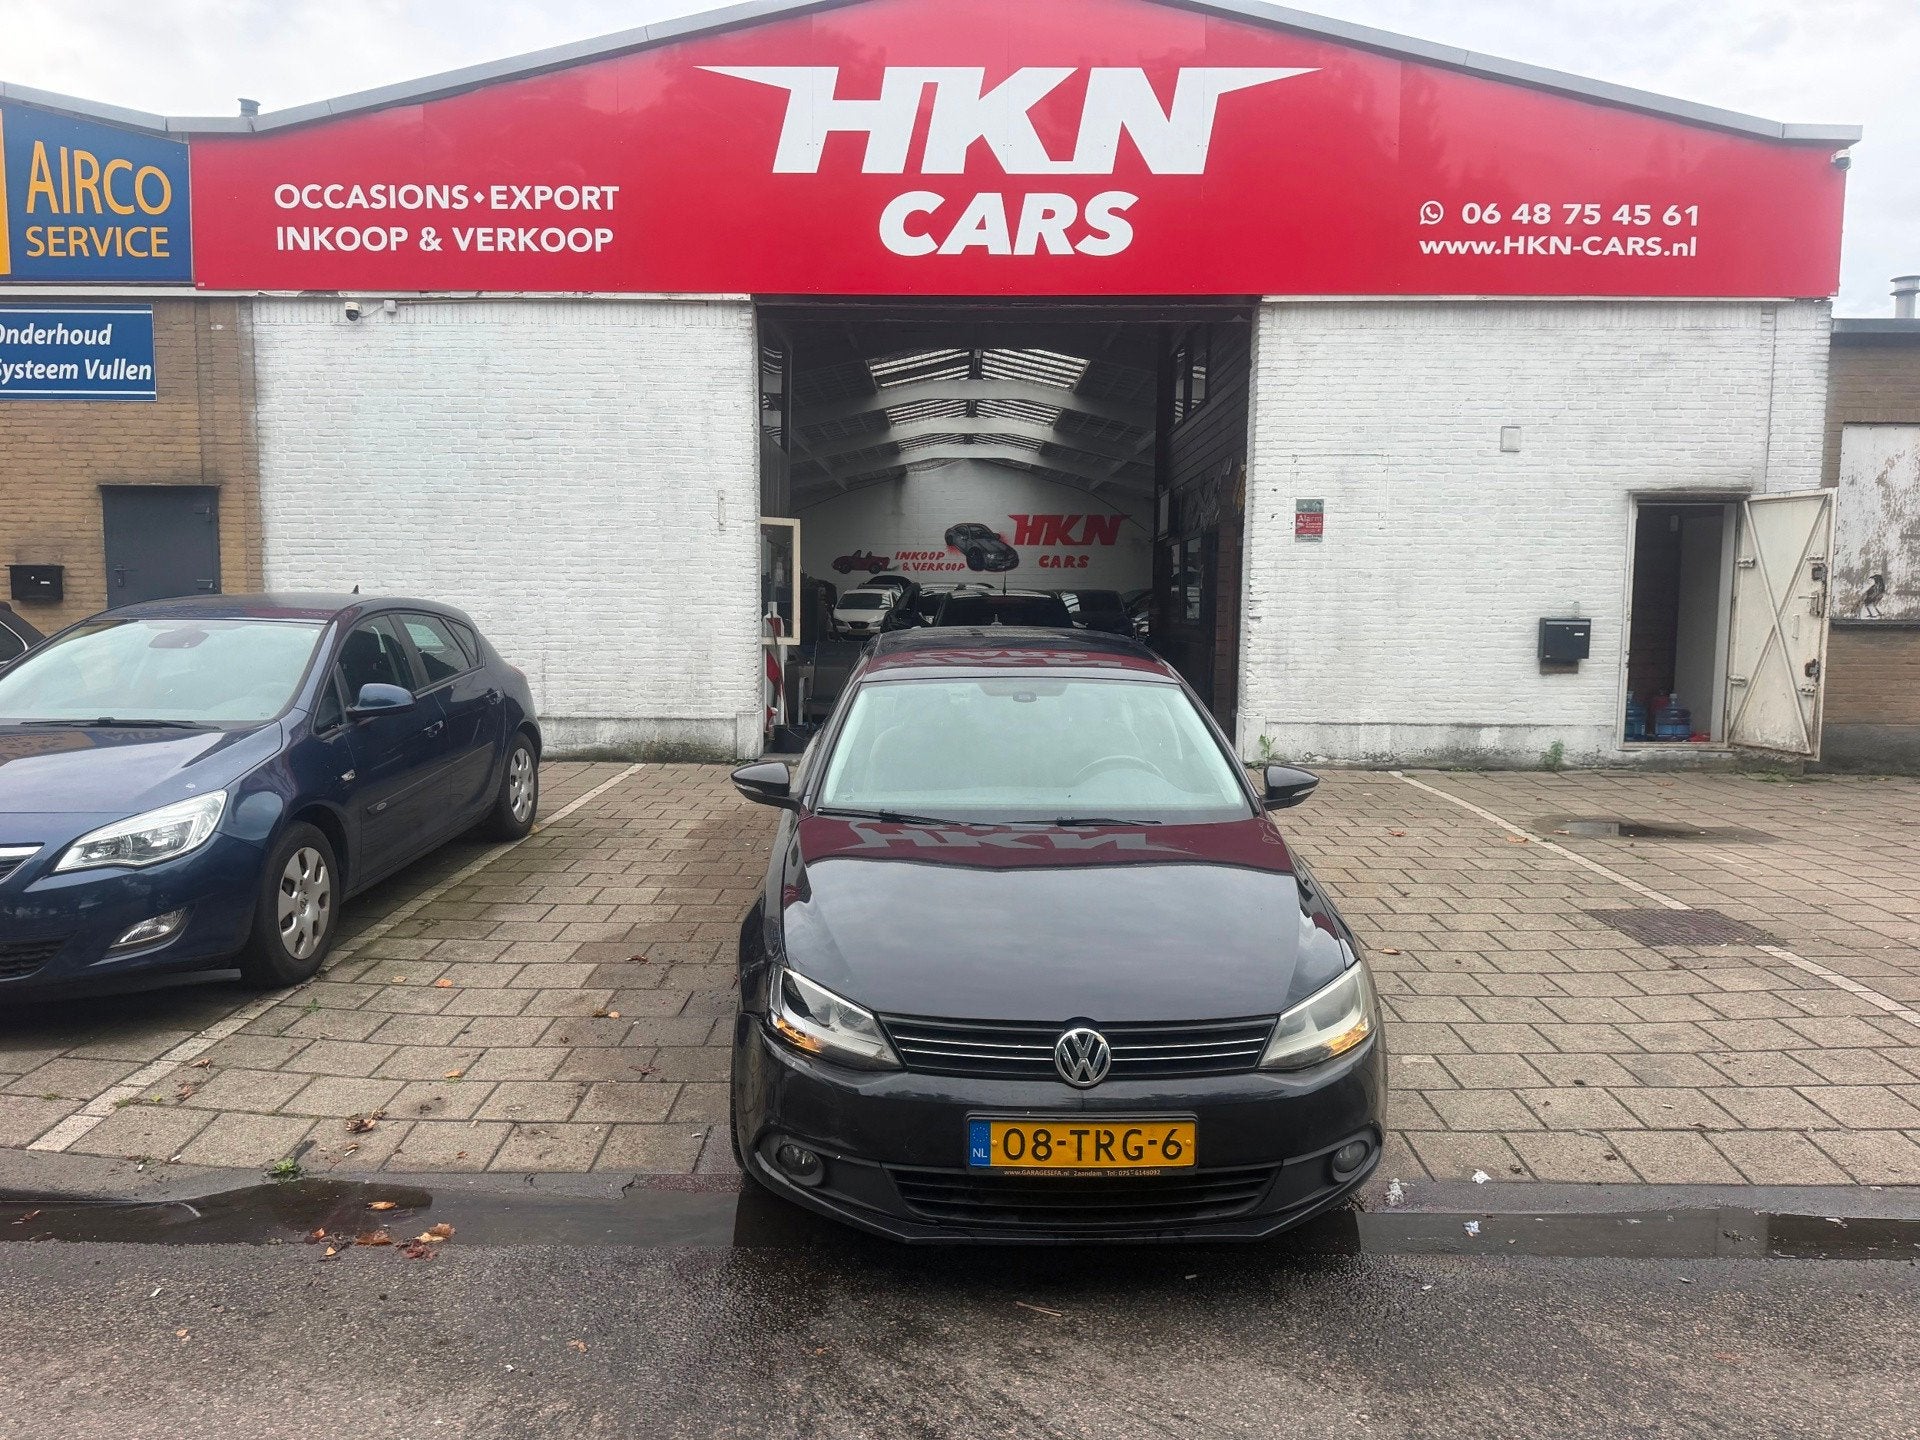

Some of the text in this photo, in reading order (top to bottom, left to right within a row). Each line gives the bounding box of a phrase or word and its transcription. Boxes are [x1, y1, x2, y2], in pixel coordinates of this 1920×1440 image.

[692, 65, 1324, 175] HKN
[26, 140, 172, 216] AIRCO
[274, 183, 620, 211] OCCASIONS EXPORT
[878, 190, 1140, 257] CARS
[1461, 202, 1699, 227] 06 48 75 45 61
[25, 225, 170, 259] SERVICE
[276, 226, 614, 253] INKOOP & VERKOOP
[1419, 235, 1697, 257] www.HKN-CARS.nl
[0, 358, 152, 386] ysteem Vullen
[1008, 514, 1133, 546] HKN
[895, 551, 946, 561] INKOOP
[902, 562, 966, 572] & VERKOOP
[1038, 554, 1090, 569] CARS
[972, 1147, 988, 1158] NL
[1002, 1127, 1184, 1162] 08-TRG-6
